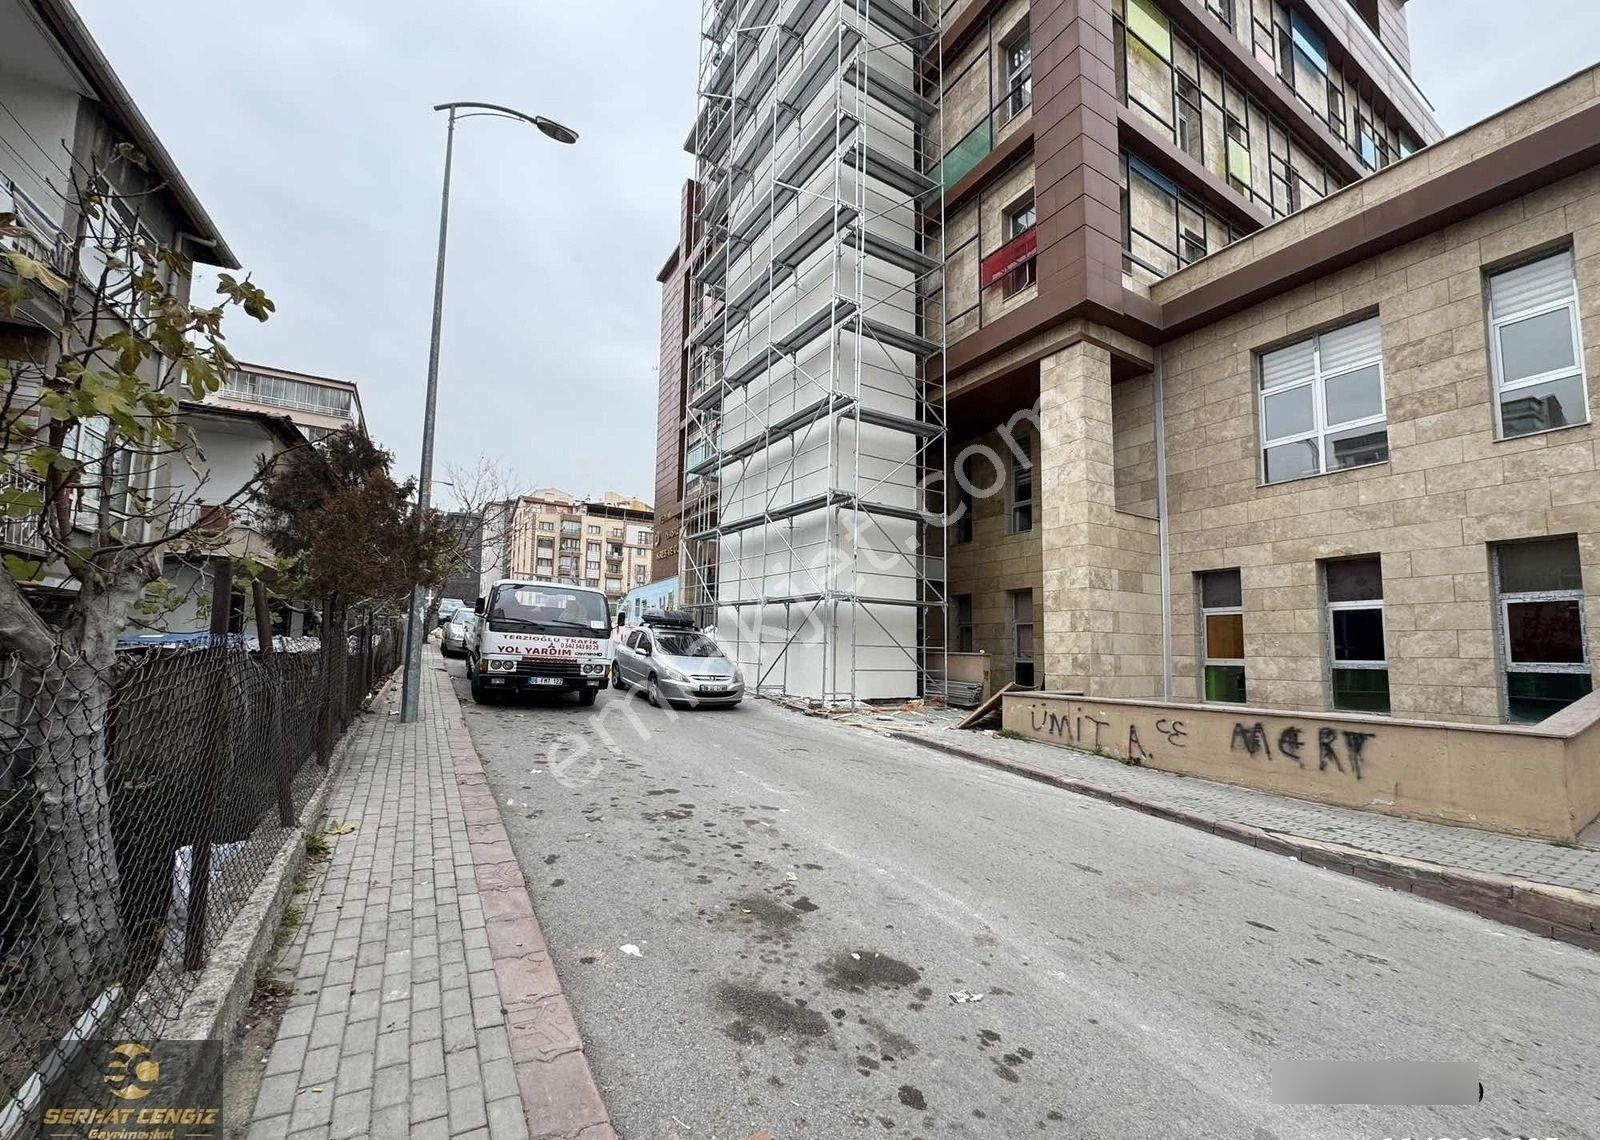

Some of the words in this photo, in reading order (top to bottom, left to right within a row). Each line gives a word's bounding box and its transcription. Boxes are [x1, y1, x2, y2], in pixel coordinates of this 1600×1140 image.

[503, 634, 560, 643] TERZİOĞLU
[497, 645, 521, 653] YOL
[525, 647, 572, 656] YARDIM
[1030, 703, 1110, 751] ÜMİT
[1230, 721, 1376, 781] MERT
